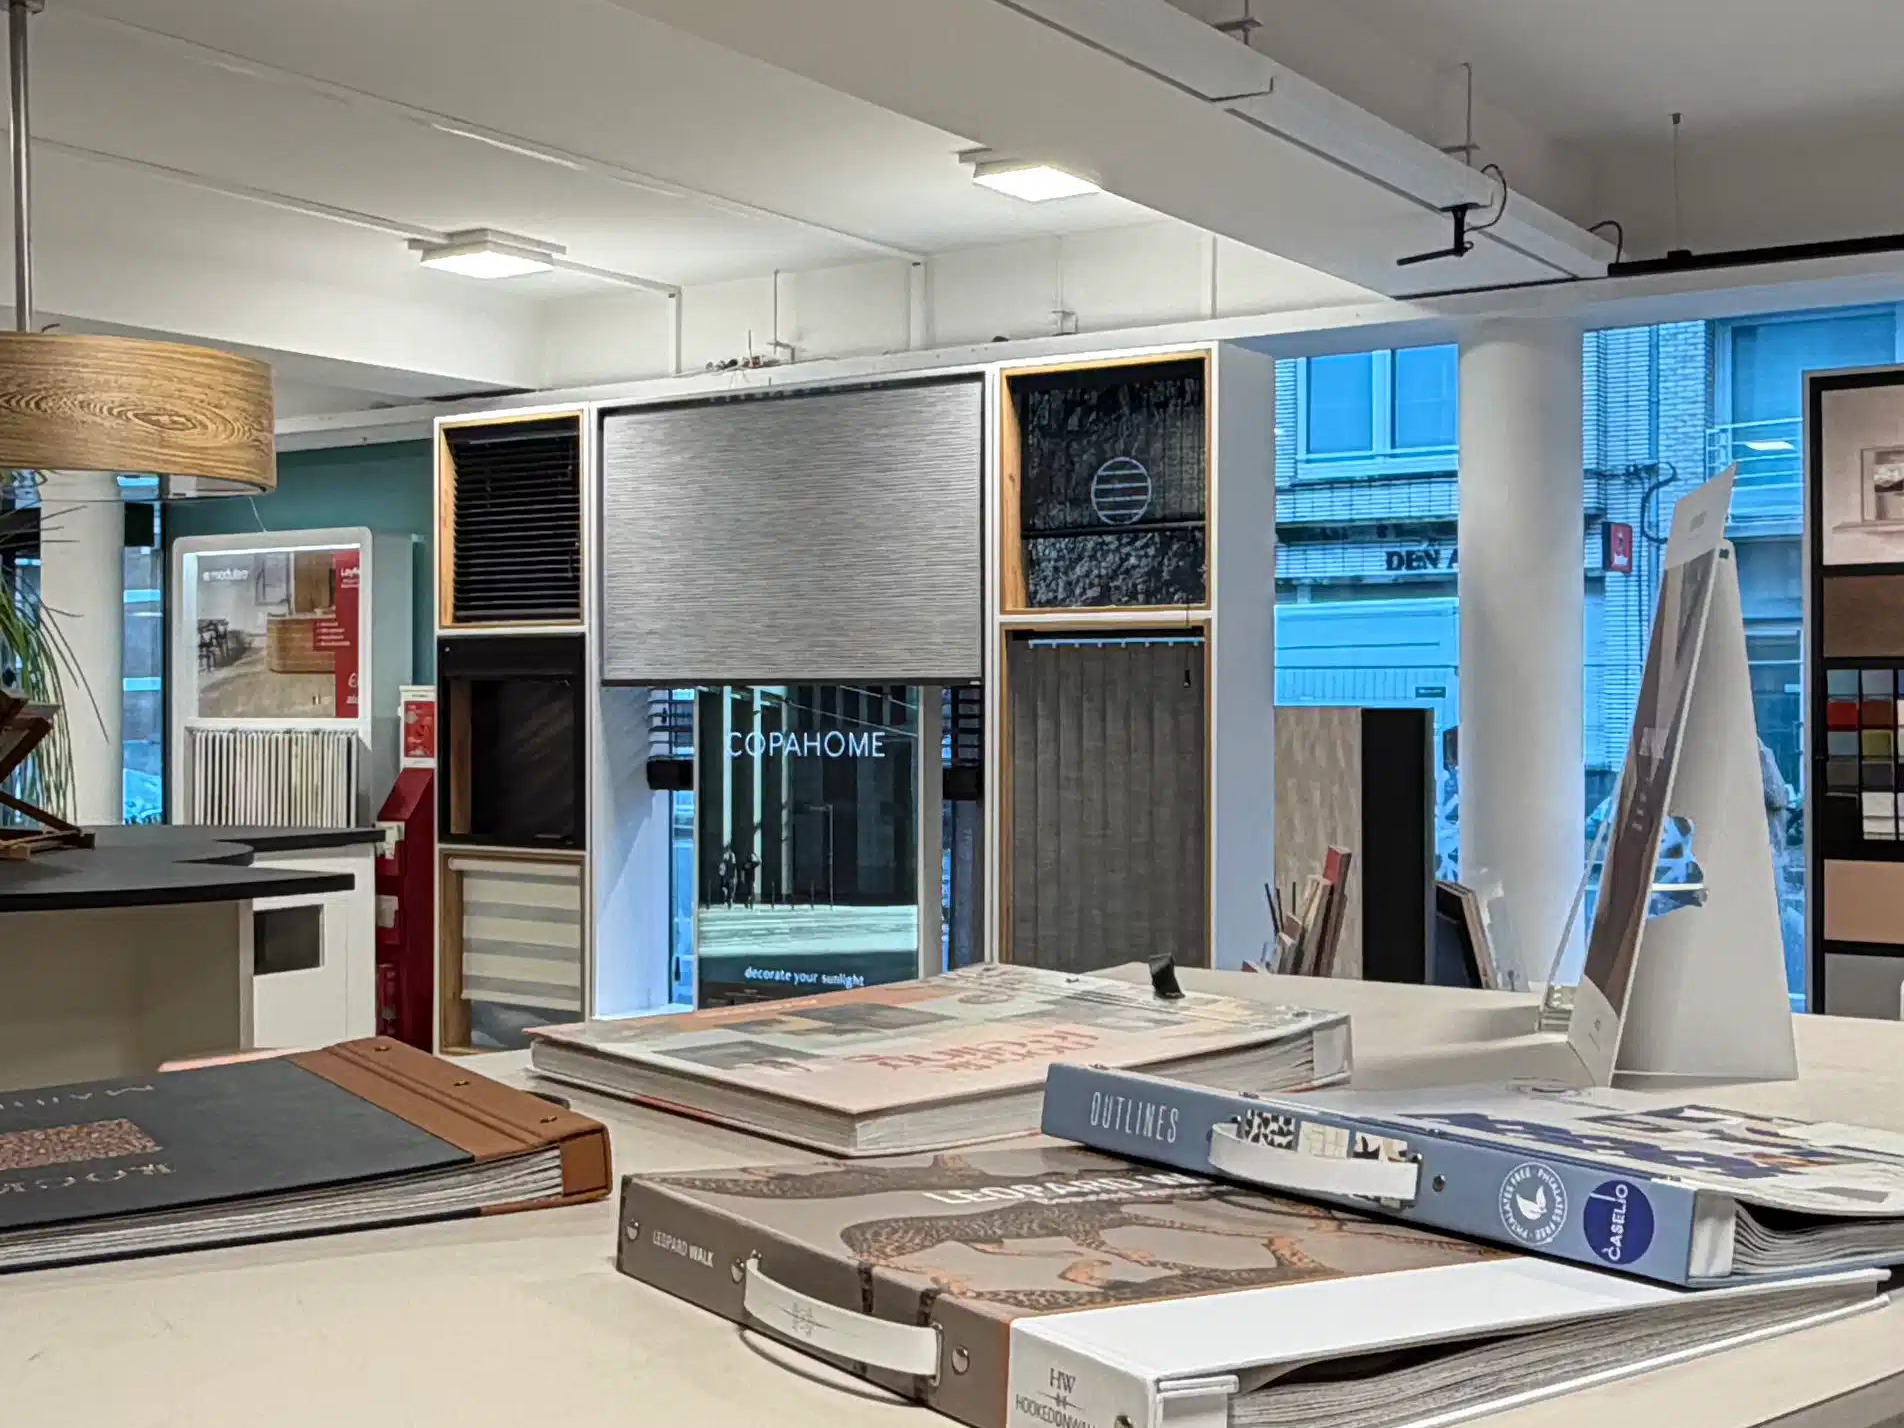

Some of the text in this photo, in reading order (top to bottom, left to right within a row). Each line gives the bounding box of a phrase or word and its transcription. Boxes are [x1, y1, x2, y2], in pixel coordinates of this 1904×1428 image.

[727, 730, 886, 759] COPAHOME
[744, 965, 865, 989] decorate your sunlight
[1090, 1091, 1179, 1144] OUTLINES
[652, 1230, 715, 1268] LEOPARD WALK
[1049, 1367, 1076, 1394] HW
